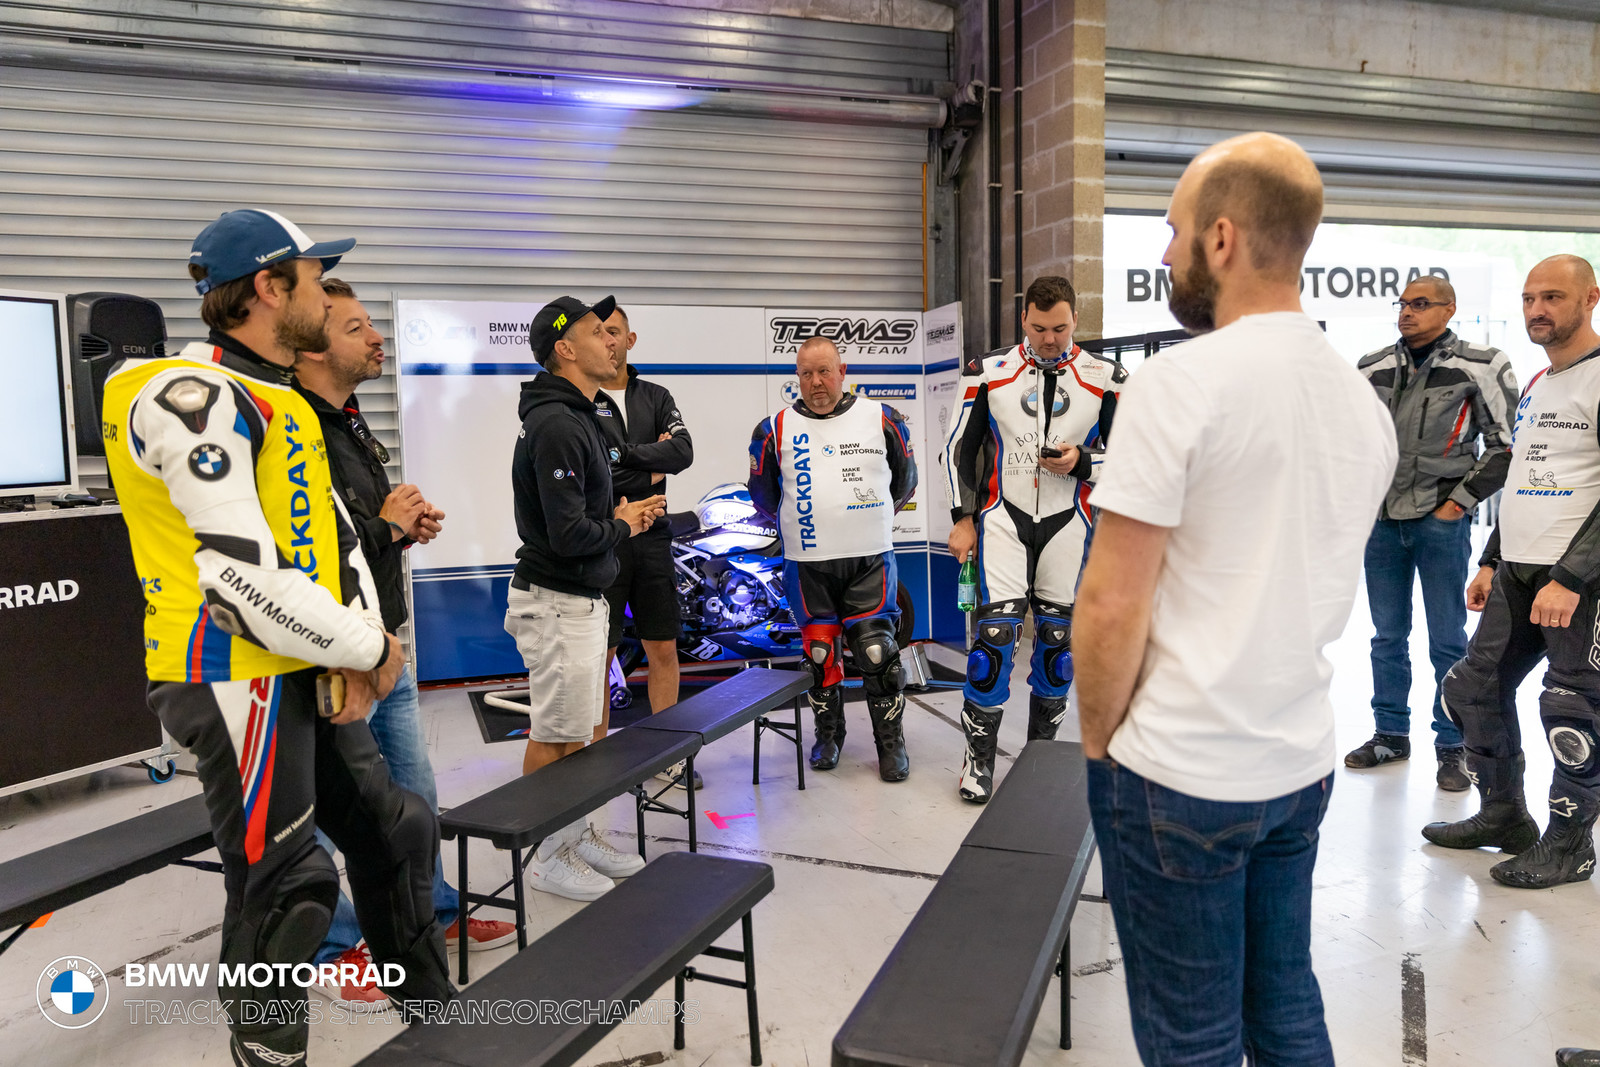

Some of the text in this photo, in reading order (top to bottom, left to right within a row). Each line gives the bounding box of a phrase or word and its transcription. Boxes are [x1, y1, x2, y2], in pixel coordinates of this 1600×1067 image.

[1127, 268, 1172, 302] BM
[489, 322, 518, 333] BMW
[553, 313, 567, 331] 78
[770, 317, 918, 345] TECMAS
[122, 345, 147, 354] EON
[773, 345, 908, 354] RAG TEAM
[1540, 412, 1558, 420] BMW
[1537, 421, 1589, 430] MOTORRAD
[840, 448, 883, 456] MOTORRAD
[284, 413, 319, 583] CKDAYS
[793, 432, 817, 551] TRACKDAYS
[1516, 489, 1574, 497] MICHELIN
[219, 566, 335, 650] BMW Motorrad
[690, 638, 720, 660] 78
[273, 826, 293, 843] BMW
